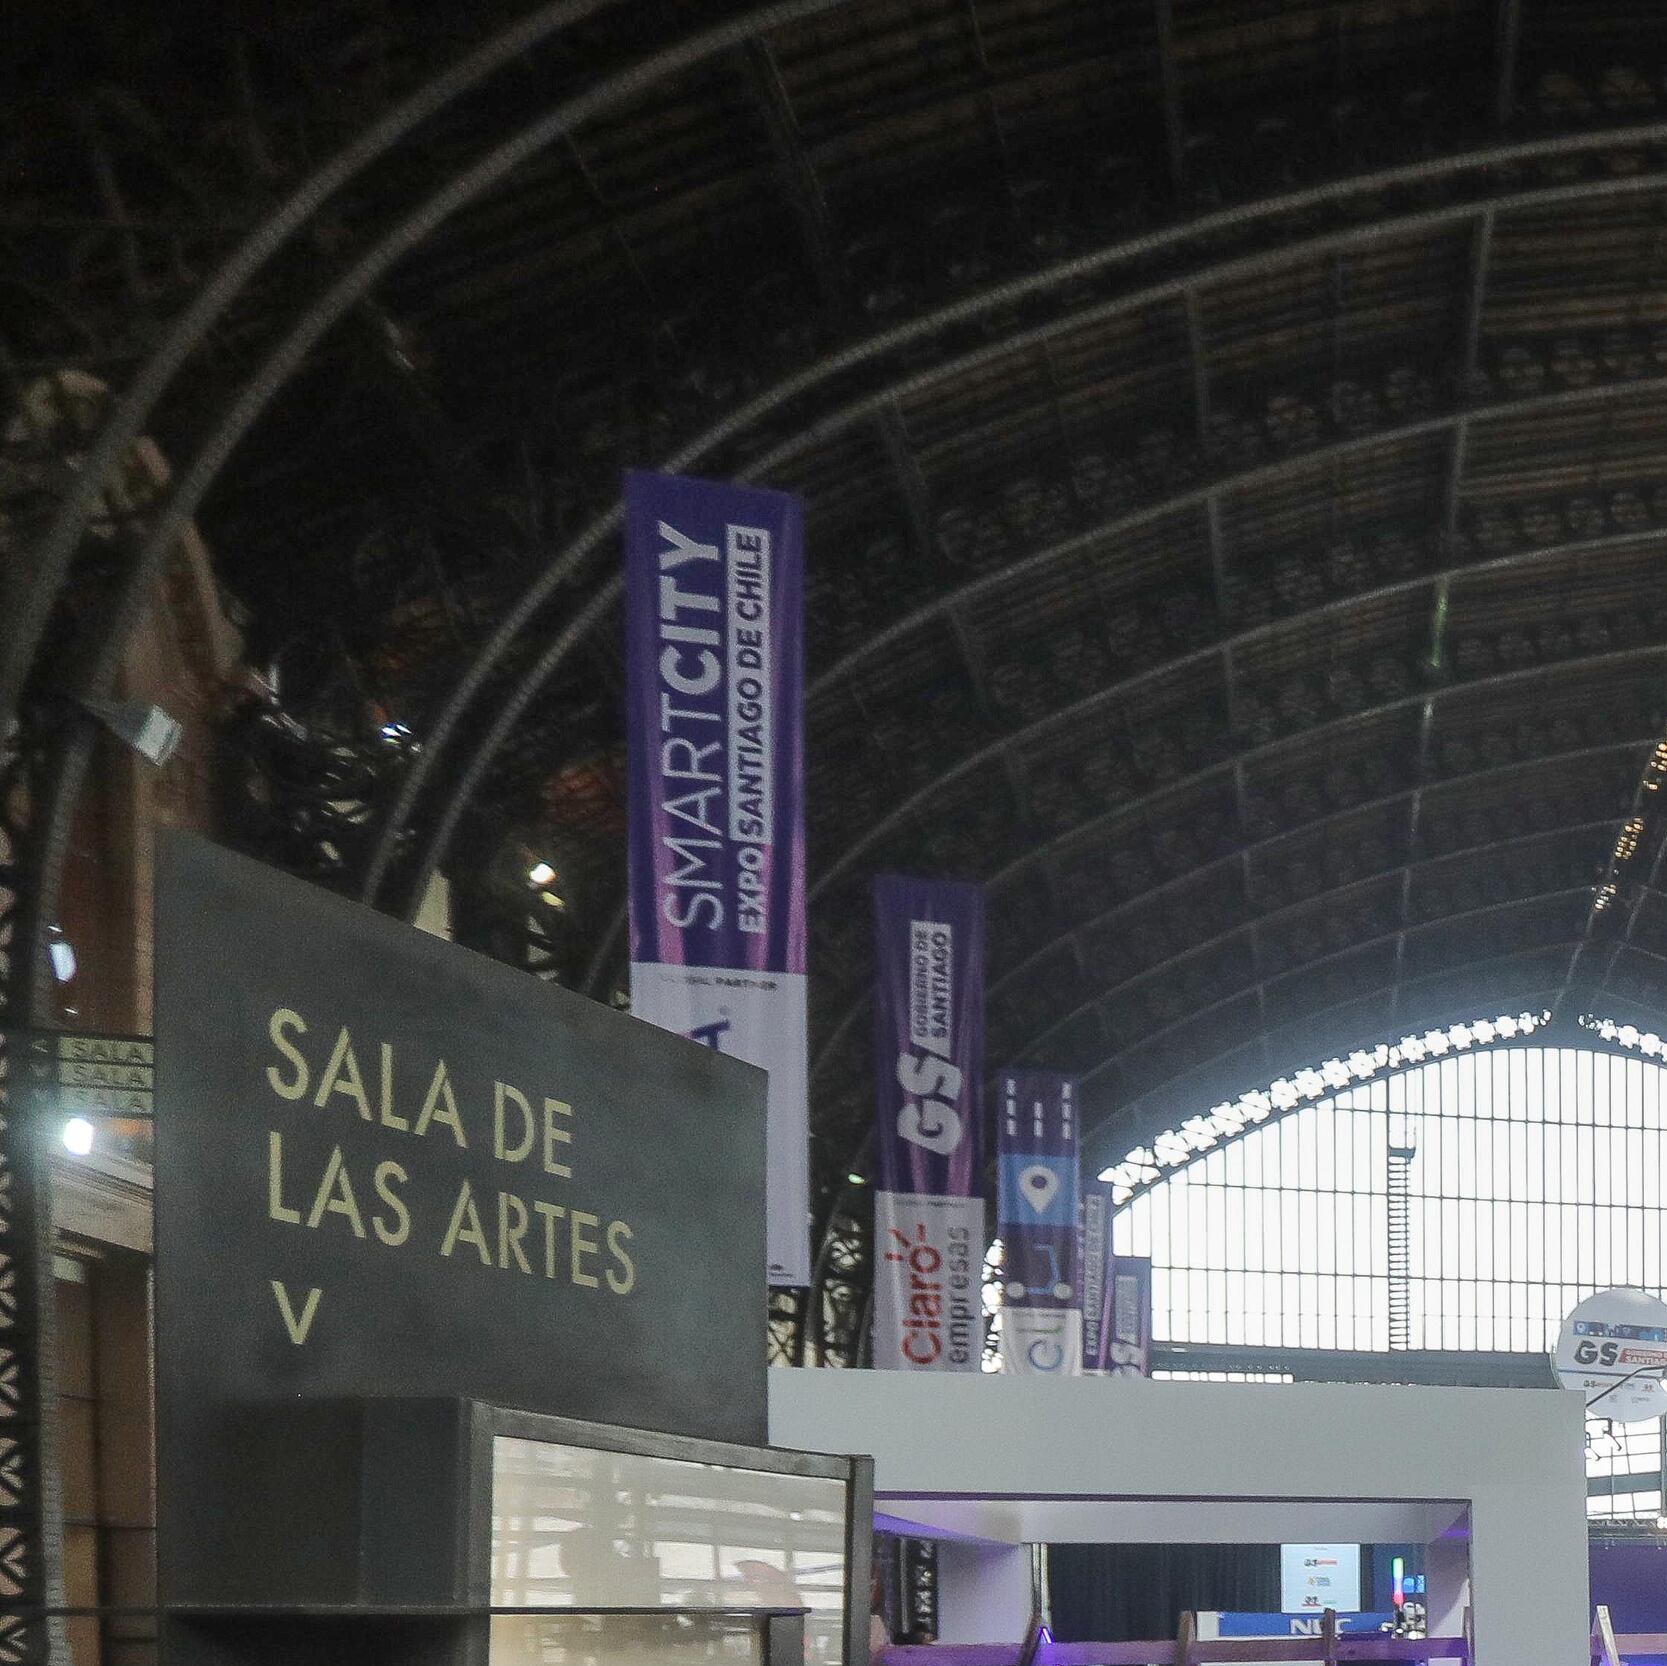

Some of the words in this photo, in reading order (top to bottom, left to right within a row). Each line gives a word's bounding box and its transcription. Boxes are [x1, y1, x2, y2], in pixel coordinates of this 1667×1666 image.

[736, 532, 763, 620] CHILE
[736, 628, 763, 662] DE
[658, 520, 725, 931] SMARTCITY
[736, 676, 764, 838] SANTIAGO
[736, 847, 768, 934] EXPO
[931, 931, 949, 1039] SANTIAGO
[266, 1007, 468, 1149] SALA
[493, 1080, 574, 1179] DE
[896, 1050, 963, 1157] GS
[268, 1131, 410, 1247] LAS
[440, 1179, 636, 1295] ARTES
[902, 1245, 943, 1365] Claro
[948, 1226, 975, 1364] empresas
[1574, 1340, 1619, 1367] GS
[1290, 1617, 1352, 1635] NC
